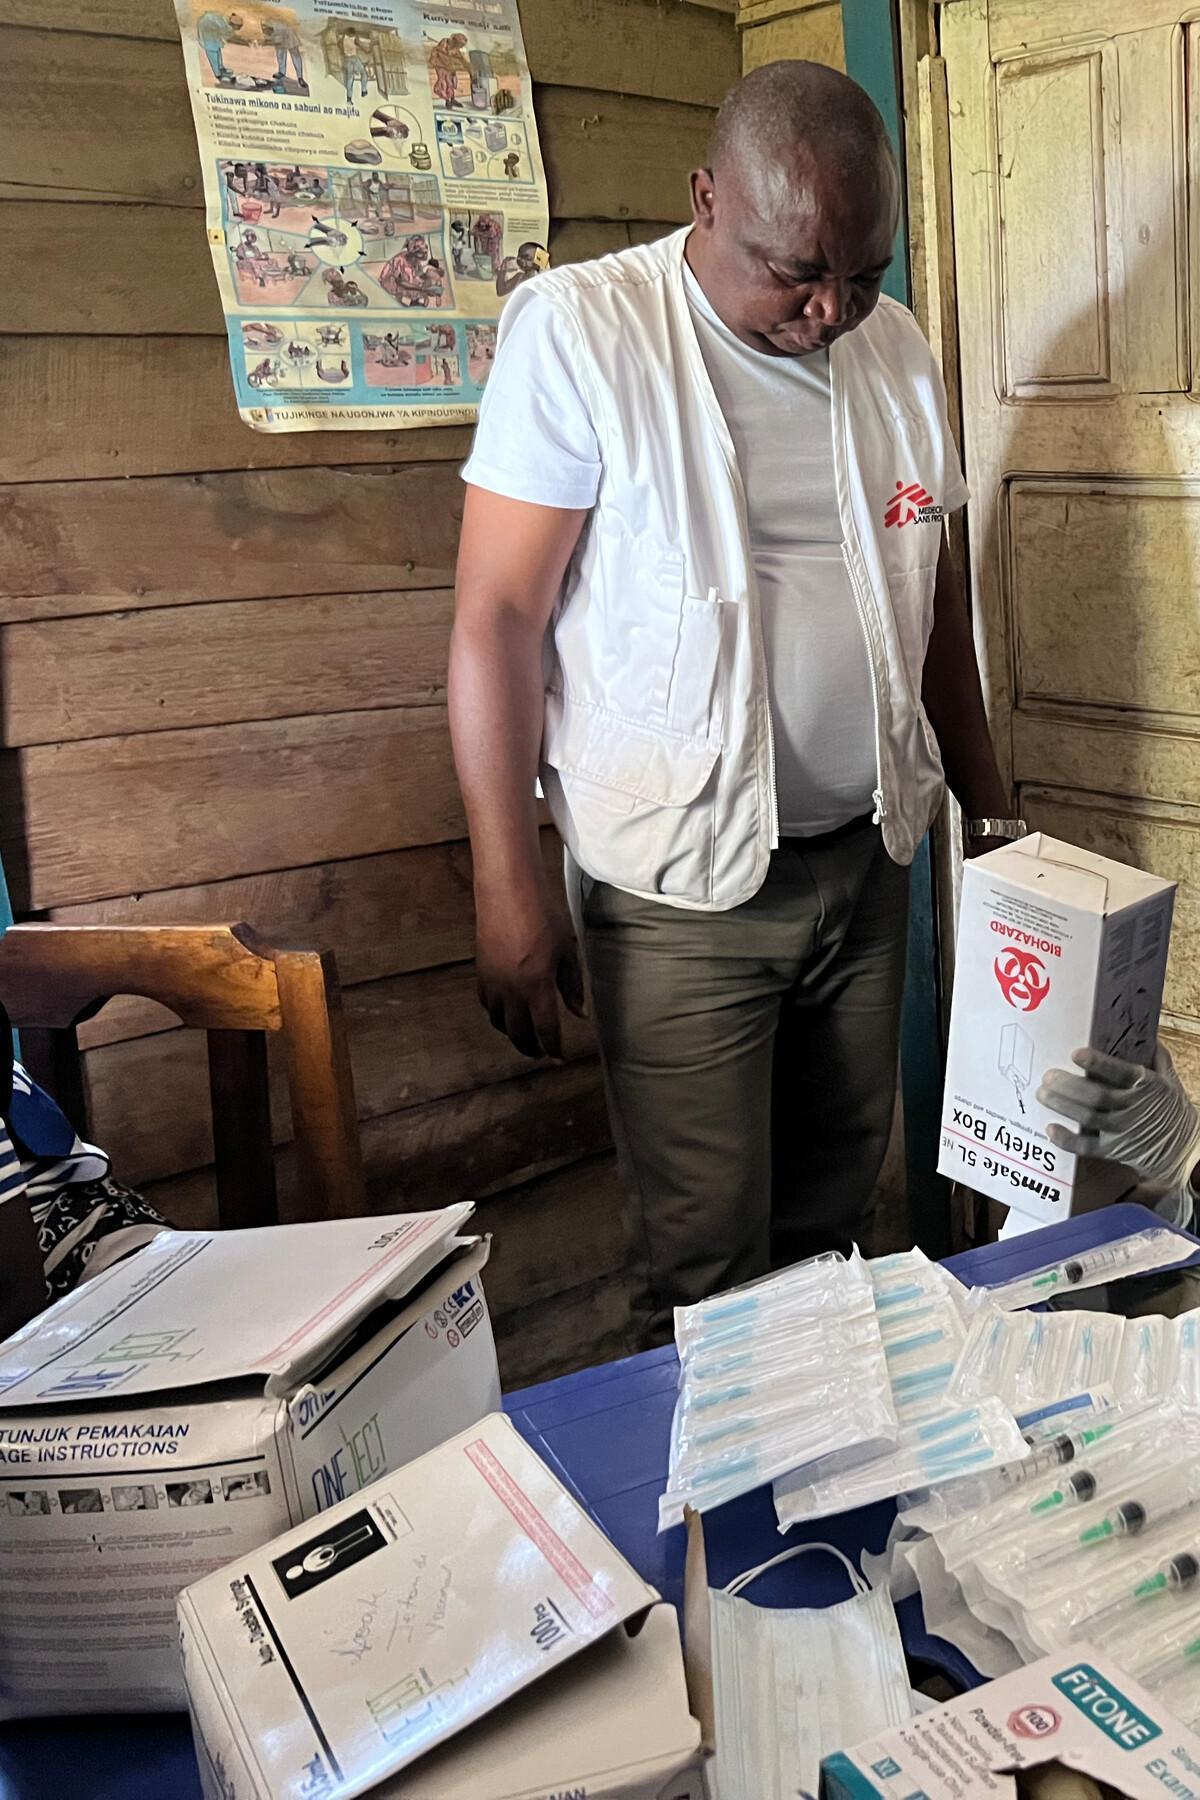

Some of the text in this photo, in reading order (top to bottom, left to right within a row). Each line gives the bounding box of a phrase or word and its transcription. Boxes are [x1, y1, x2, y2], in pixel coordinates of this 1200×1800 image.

[206, 93, 246, 105] Tukinawa
[248, 98, 279, 109] mikono
[293, 103, 321, 113] sabuni
[334, 108, 359, 118] majifu
[275, 411, 328, 419] TUJIKINGE
[330, 410, 345, 419] NA
[346, 409, 395, 418] UGONJWA
[990, 920, 1062, 957] BIOHAZARD
[953, 1108, 1056, 1172] Safety Box
[958, 1144, 977, 1167] 5L
[77, 1424, 190, 1440] PEMAKAIAN
[38, 1441, 179, 1462] INSTRUCTIONS
[530, 1619, 566, 1651] 100
[1026, 1711, 1049, 1732] 100
